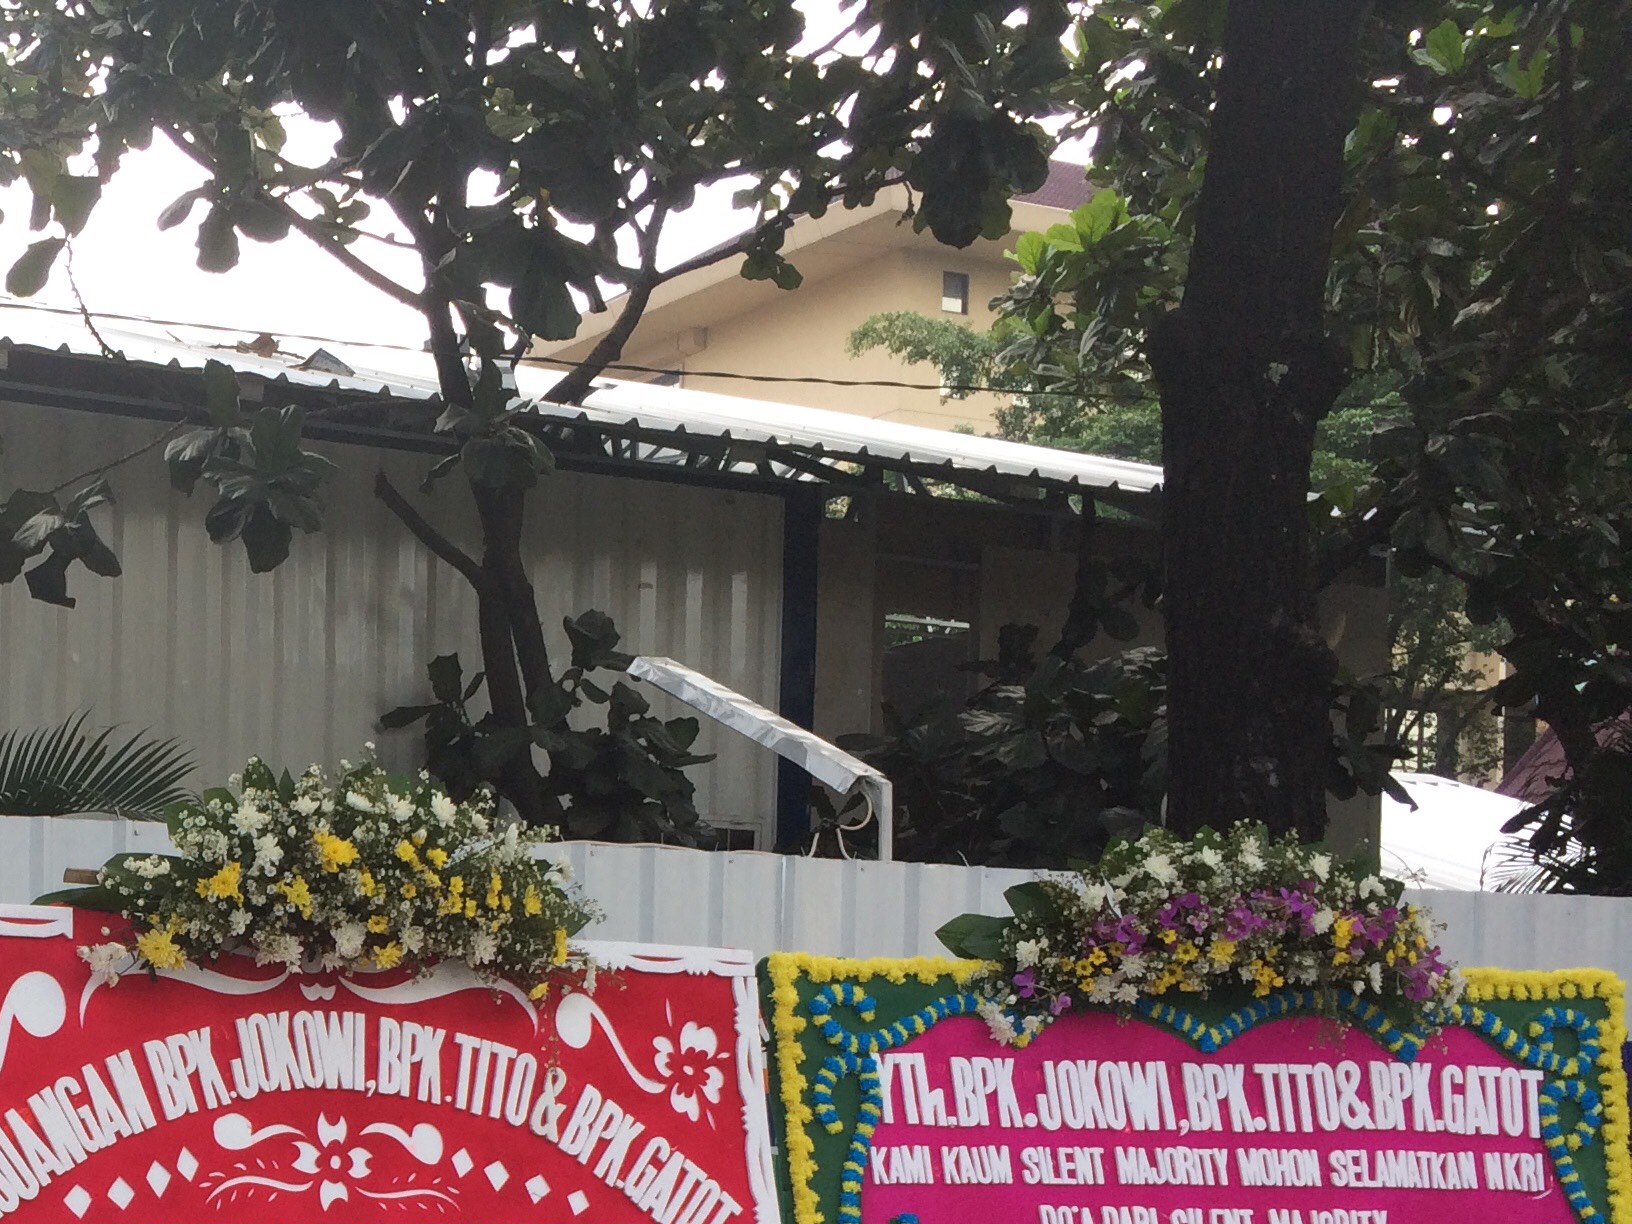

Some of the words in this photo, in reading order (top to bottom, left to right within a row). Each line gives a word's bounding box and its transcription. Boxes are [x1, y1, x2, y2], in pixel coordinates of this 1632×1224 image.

[869, 1145, 935, 1185] KAMI
[941, 1145, 1014, 1185] KAUM
[1020, 1146, 1106, 1186] SILENT
[1115, 1146, 1229, 1187] MAJORITY
[1235, 1148, 1323, 1188] MOHON
[1328, 1149, 1479, 1191] SELAMATKAN
[1483, 1152, 1546, 1192] NKRI
